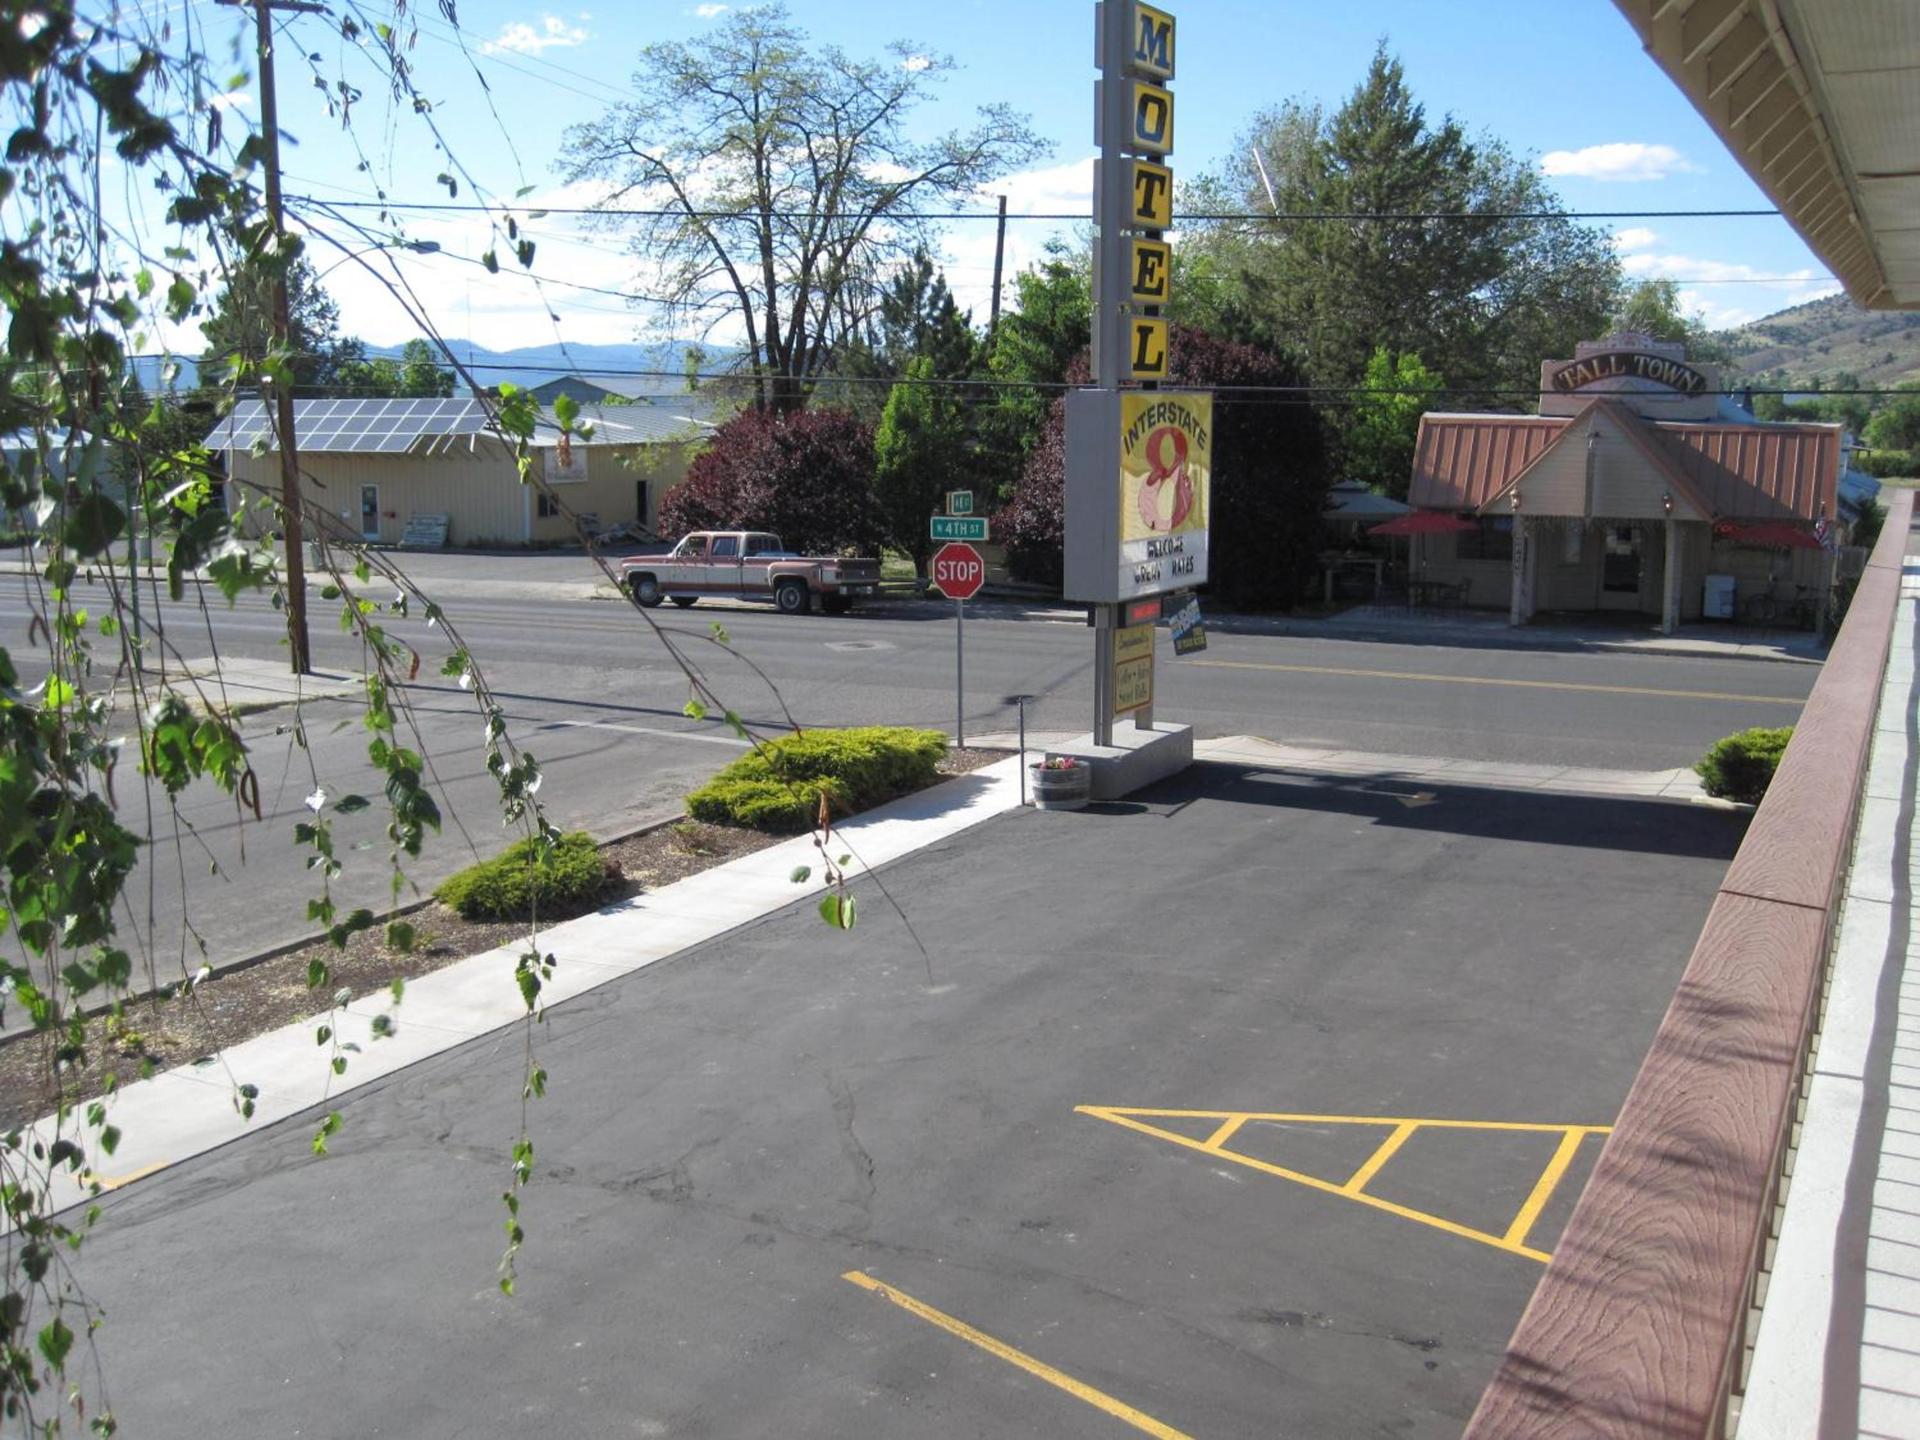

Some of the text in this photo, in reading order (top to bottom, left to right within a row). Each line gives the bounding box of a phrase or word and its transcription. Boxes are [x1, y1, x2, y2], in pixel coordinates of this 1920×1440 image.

[1132, 14, 1171, 372] MOTEL
[1558, 355, 1699, 392] TALL TOWN
[1123, 402, 1207, 456] INTERSTATE
[945, 521, 968, 536] 4TH
[937, 561, 979, 582] STOP
